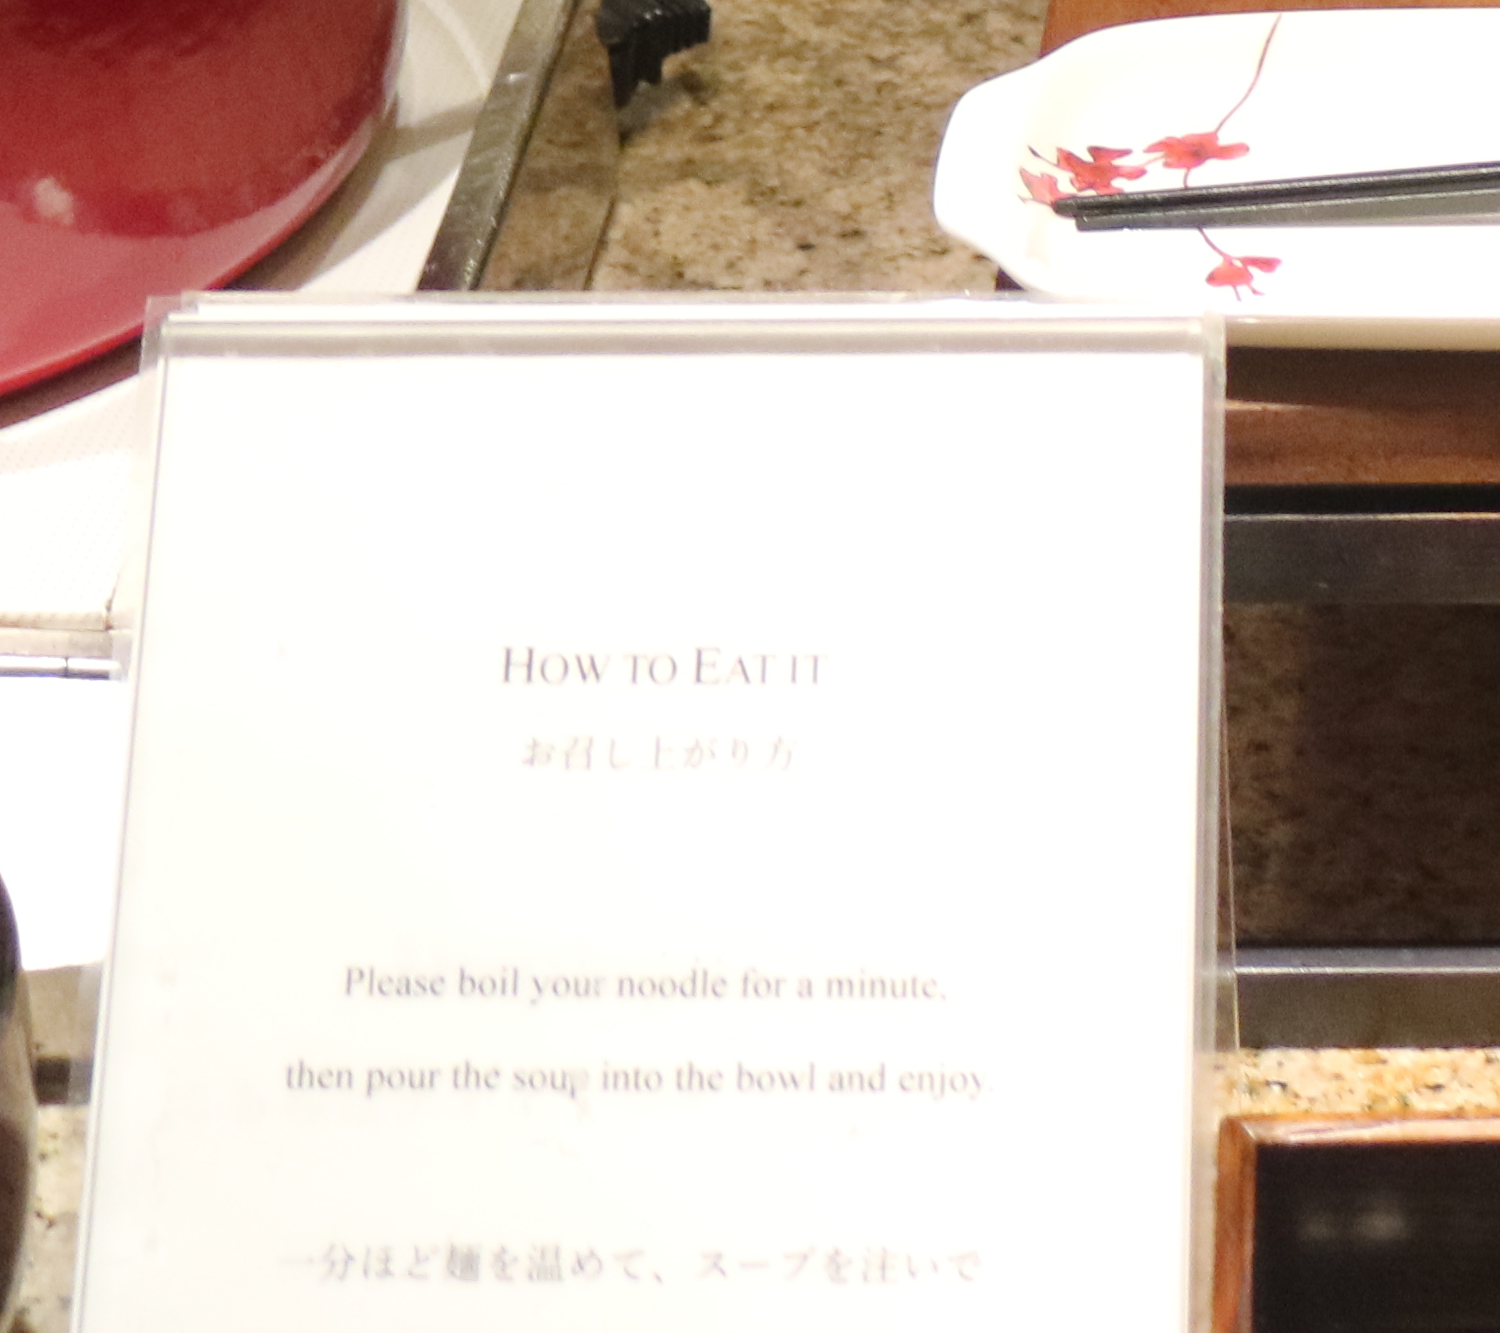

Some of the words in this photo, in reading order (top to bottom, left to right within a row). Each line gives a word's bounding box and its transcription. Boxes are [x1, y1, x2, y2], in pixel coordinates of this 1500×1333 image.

[521, 735, 798, 771] お召し上がり方
[345, 966, 446, 998] Please
[458, 965, 520, 998] boil
[530, 975, 603, 1006] your
[617, 965, 729, 999] noodle
[741, 966, 787, 999] for
[796, 976, 814, 999] a
[286, 1059, 352, 1092] then
[365, 1067, 442, 1099] pour
[452, 1059, 500, 1092] the
[512, 1067, 590, 1100] soup
[602, 1060, 663, 1092] into
[673, 1060, 725, 1093] the
[736, 1061, 816, 1093] bowl
[827, 1061, 887, 1093] and
